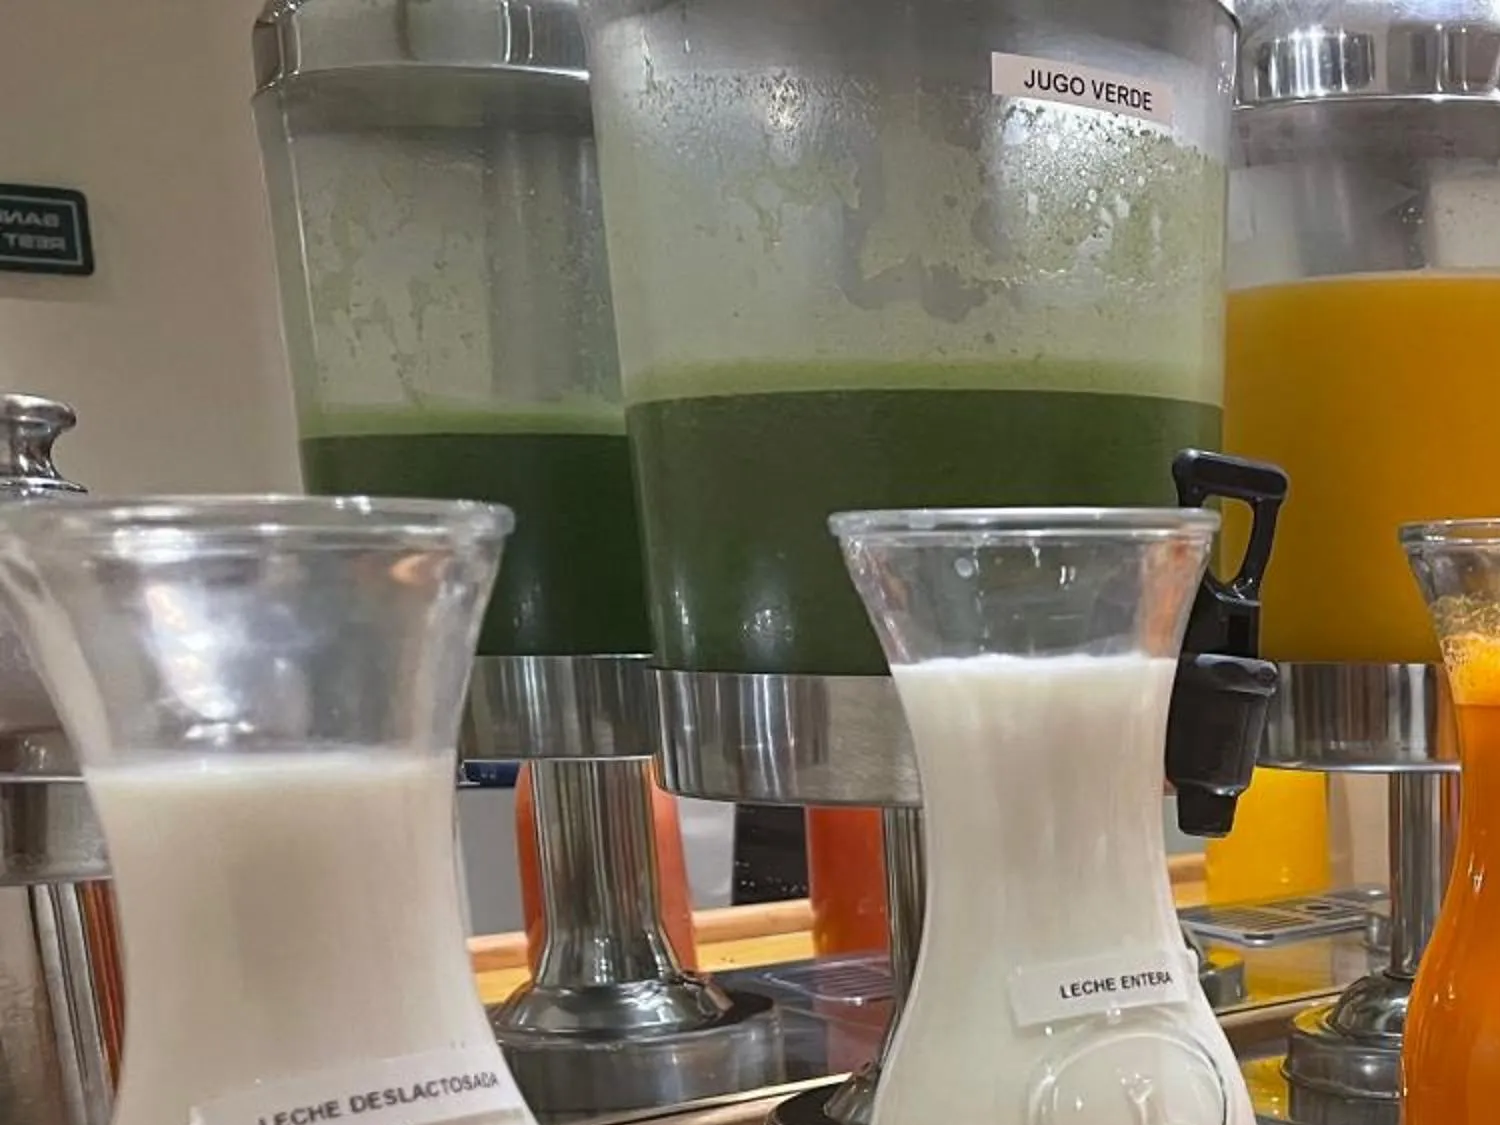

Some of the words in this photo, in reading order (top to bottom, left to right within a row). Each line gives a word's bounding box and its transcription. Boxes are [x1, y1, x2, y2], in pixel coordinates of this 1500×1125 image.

[1023, 69, 1085, 97] JUGO
[1091, 79, 1153, 111] VERDE
[1060, 977, 1117, 999] LECHE
[1121, 971, 1172, 989] ENTERA
[349, 1071, 498, 1113] DESLACTOSADA
